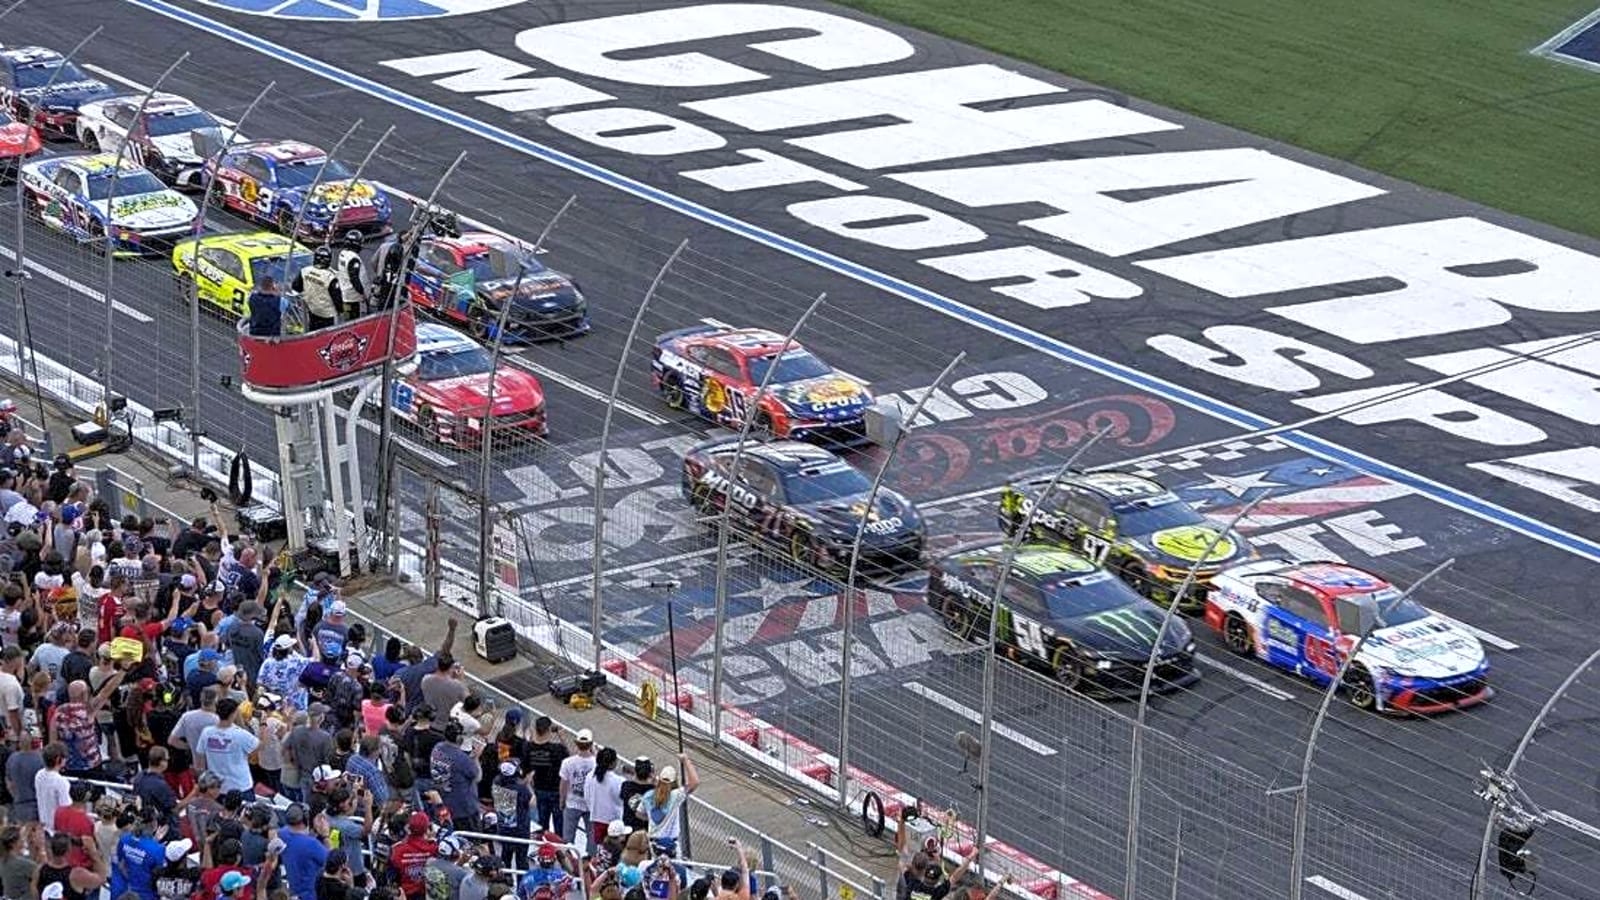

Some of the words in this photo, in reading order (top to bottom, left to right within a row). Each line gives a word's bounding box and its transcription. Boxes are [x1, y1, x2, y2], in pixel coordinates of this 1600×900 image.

[379, 49, 1144, 310] MOTOR
[256, 187, 274, 214] 3
[726, 385, 746, 418] 19
[811, 396, 863, 413] CLUB
[1084, 533, 1110, 566] 97
[1013, 613, 1047, 660] 54
[1366, 626, 1432, 648] Mobil
